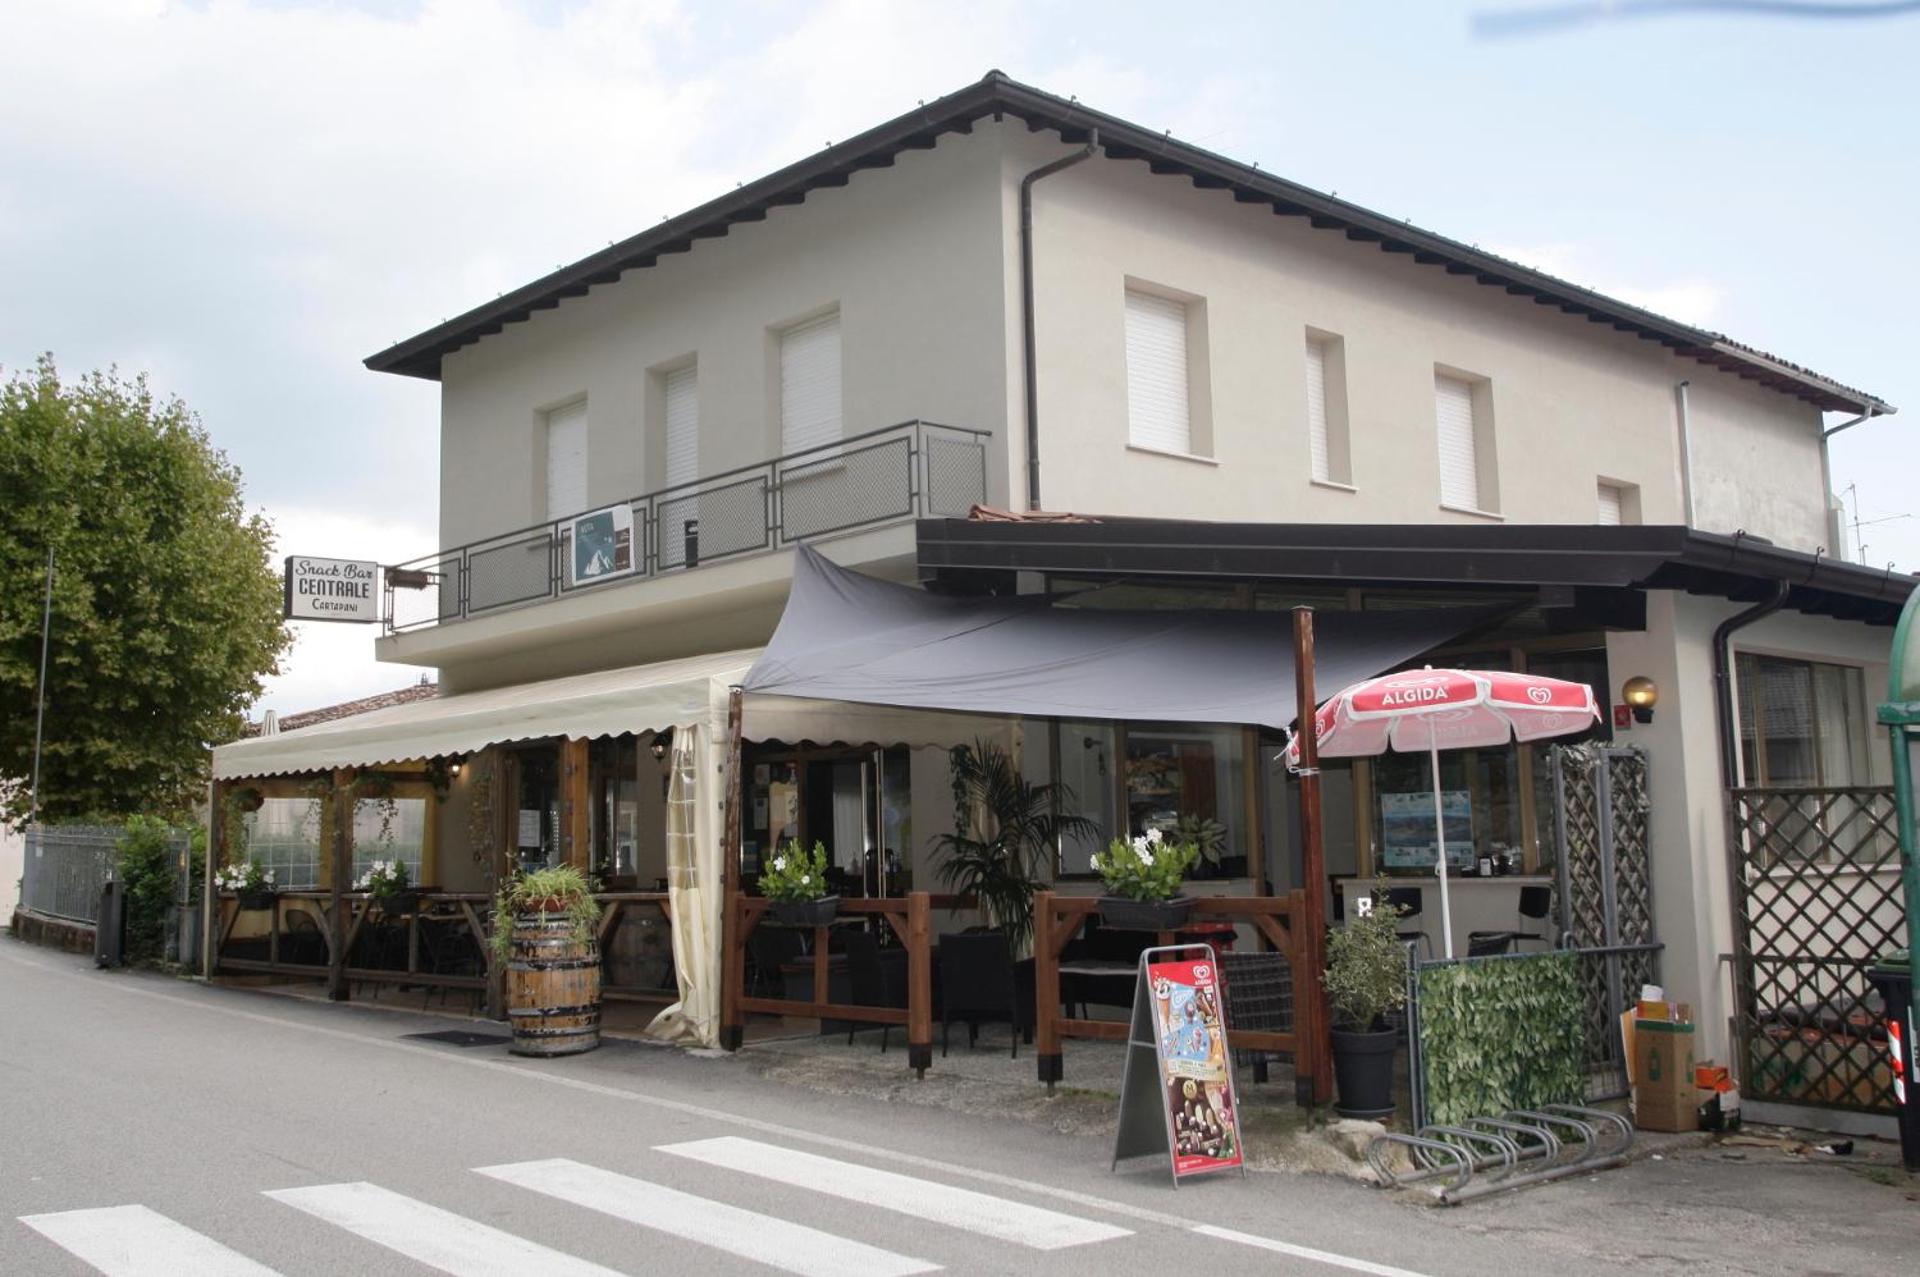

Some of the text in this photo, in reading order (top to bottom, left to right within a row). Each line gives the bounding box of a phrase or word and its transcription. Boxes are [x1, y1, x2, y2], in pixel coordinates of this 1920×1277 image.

[295, 560, 373, 579] Snack Bar
[299, 578, 369, 599] CENTRALE
[1382, 687, 1448, 705] ALGIDA
